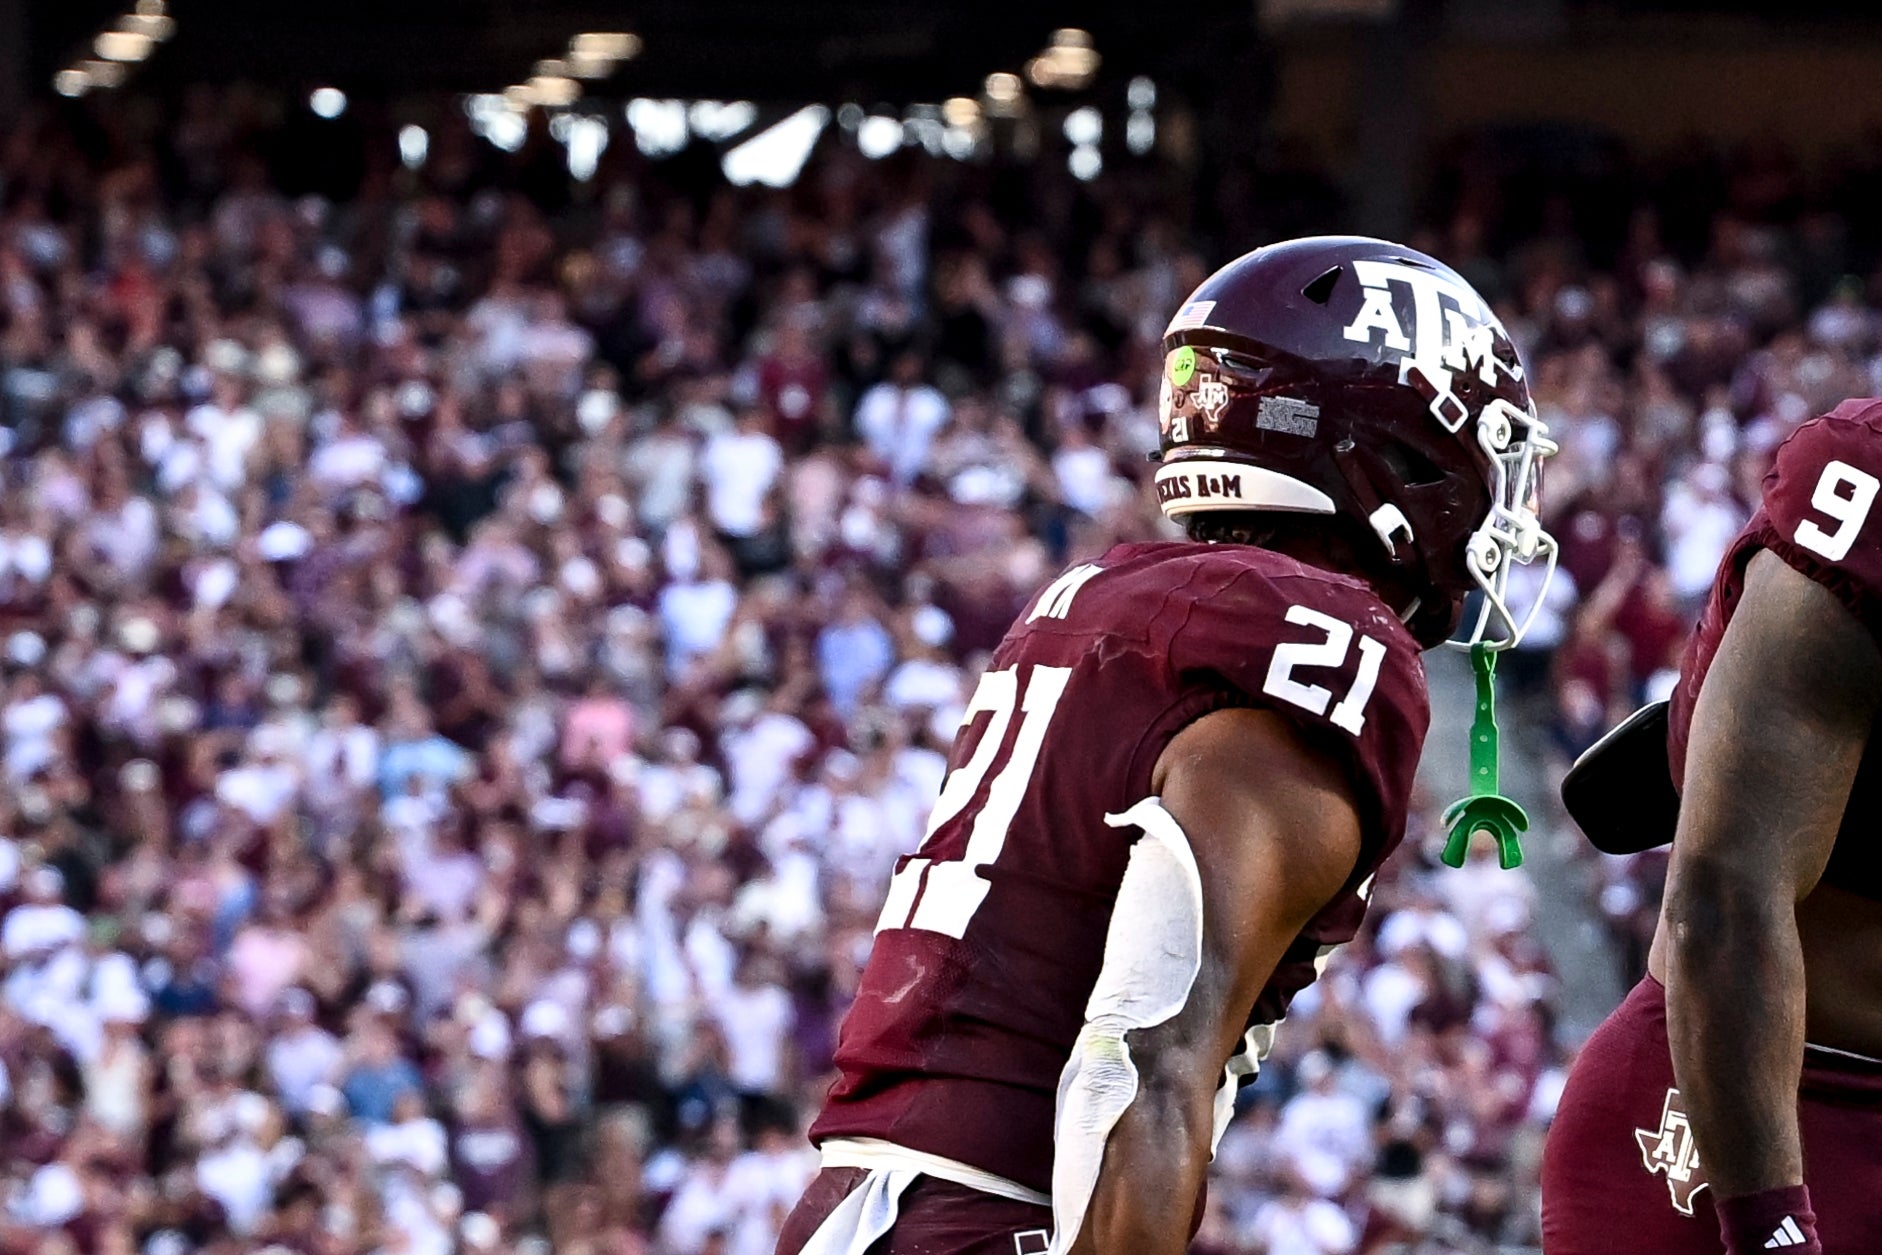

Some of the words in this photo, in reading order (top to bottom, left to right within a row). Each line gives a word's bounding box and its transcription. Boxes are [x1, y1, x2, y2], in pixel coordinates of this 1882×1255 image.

[1171, 417, 1188, 442] 21
[1793, 460, 1881, 562] 9
[1262, 604, 1388, 737] 21
